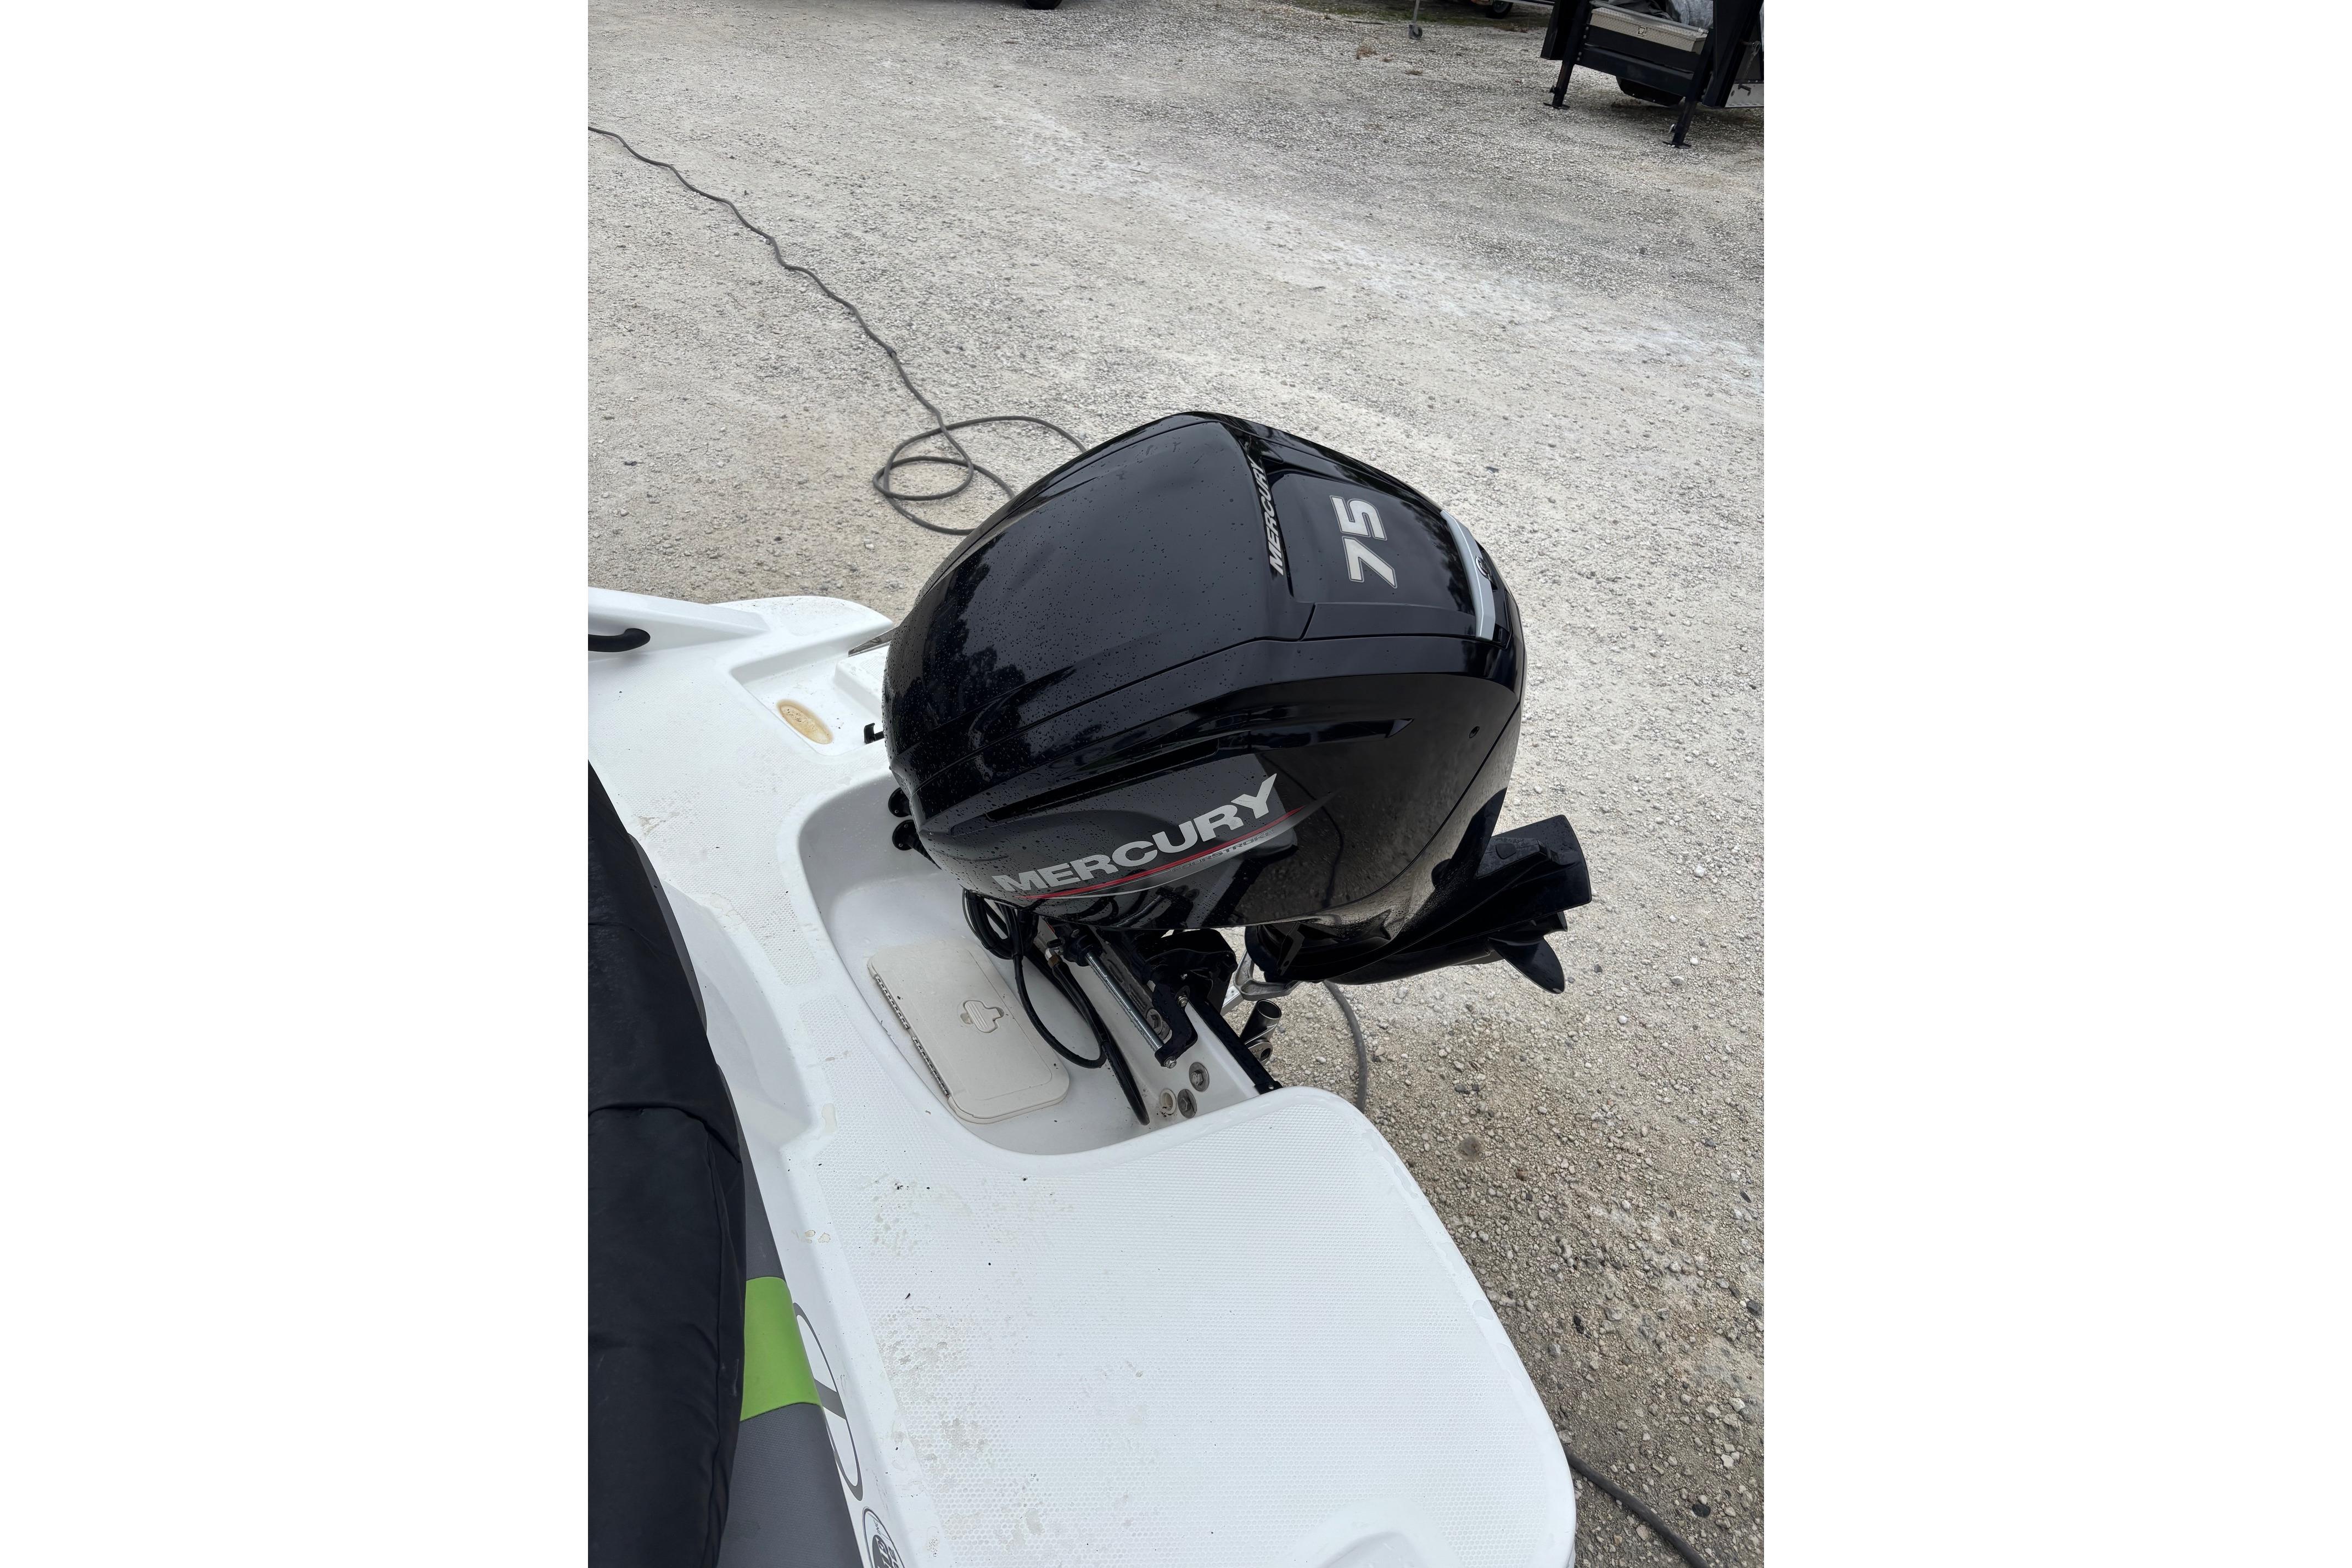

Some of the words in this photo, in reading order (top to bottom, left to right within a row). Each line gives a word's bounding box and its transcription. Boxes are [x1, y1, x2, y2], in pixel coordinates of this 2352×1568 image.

[1248, 457, 1284, 575] MERCURY
[1329, 495, 1398, 589] 75
[991, 772, 1278, 892] MERCURY
[1171, 828, 1275, 873] FOURSTROKE
